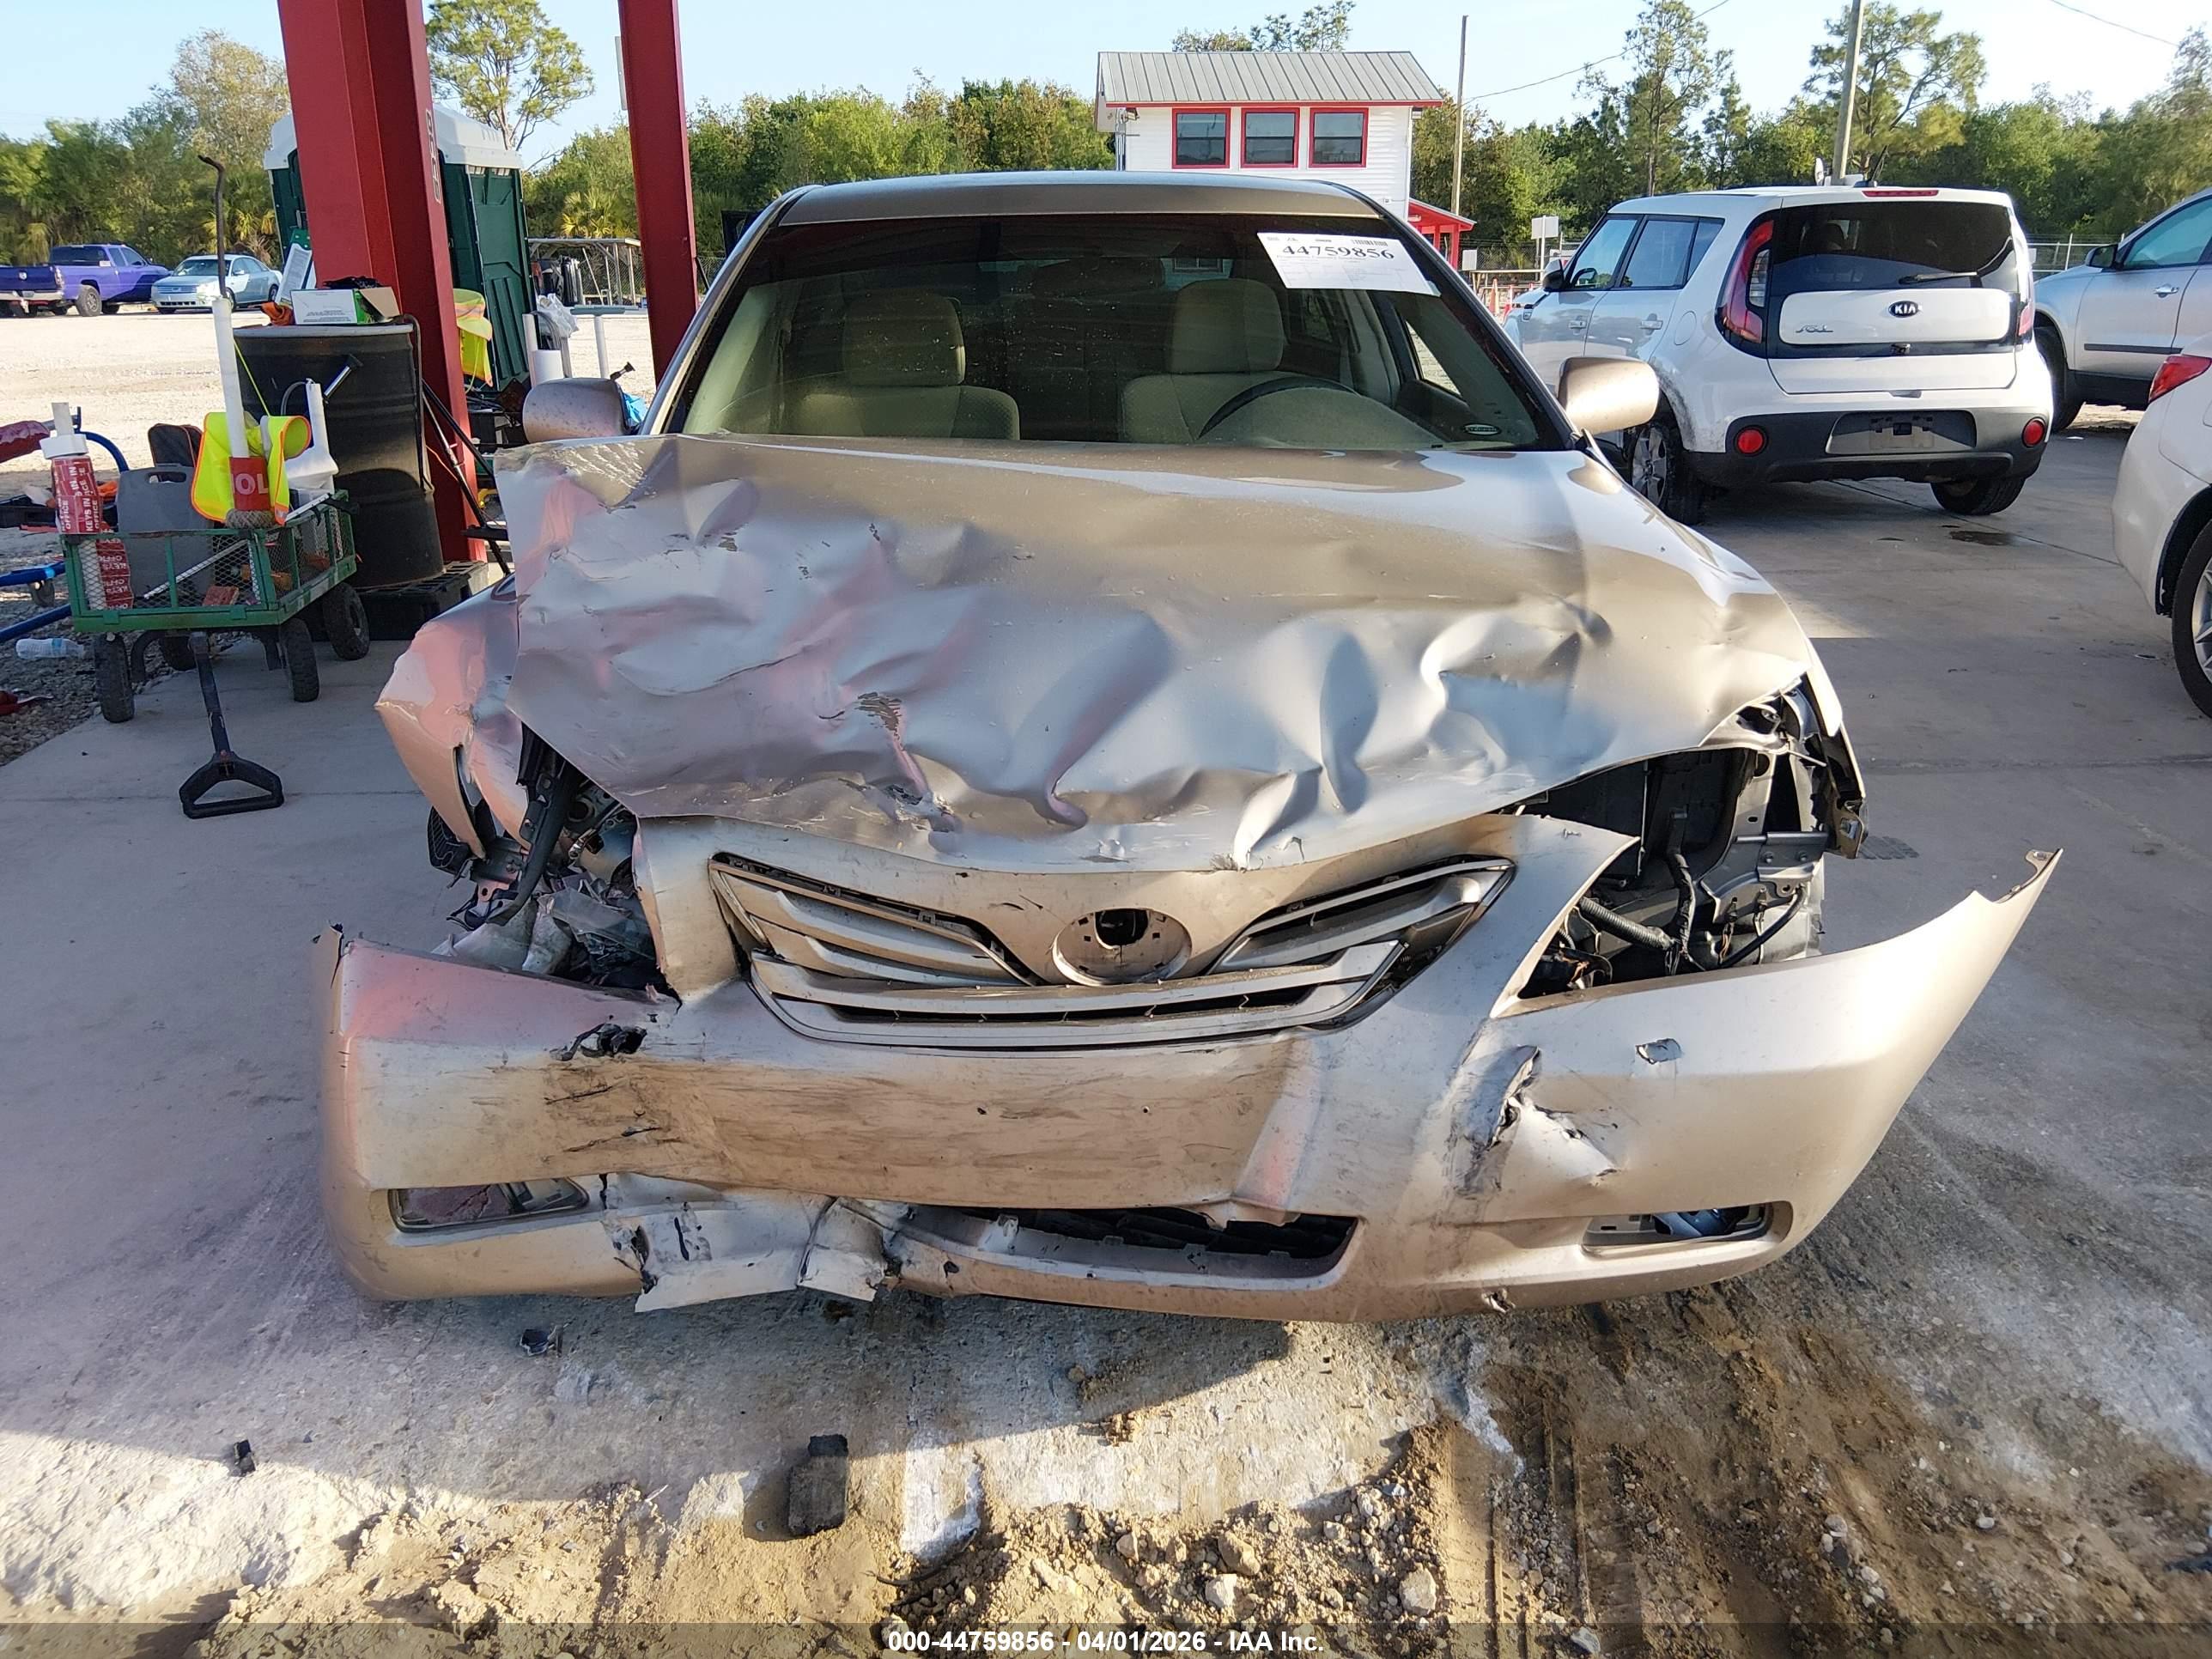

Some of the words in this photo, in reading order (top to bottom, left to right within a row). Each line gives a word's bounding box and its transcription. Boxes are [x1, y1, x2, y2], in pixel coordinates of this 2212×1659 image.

[1282, 246, 1395, 259] 44759856
[1894, 304, 1917, 315] KIA
[83, 498, 91, 507] IN
[84, 510, 94, 532] KEYS
